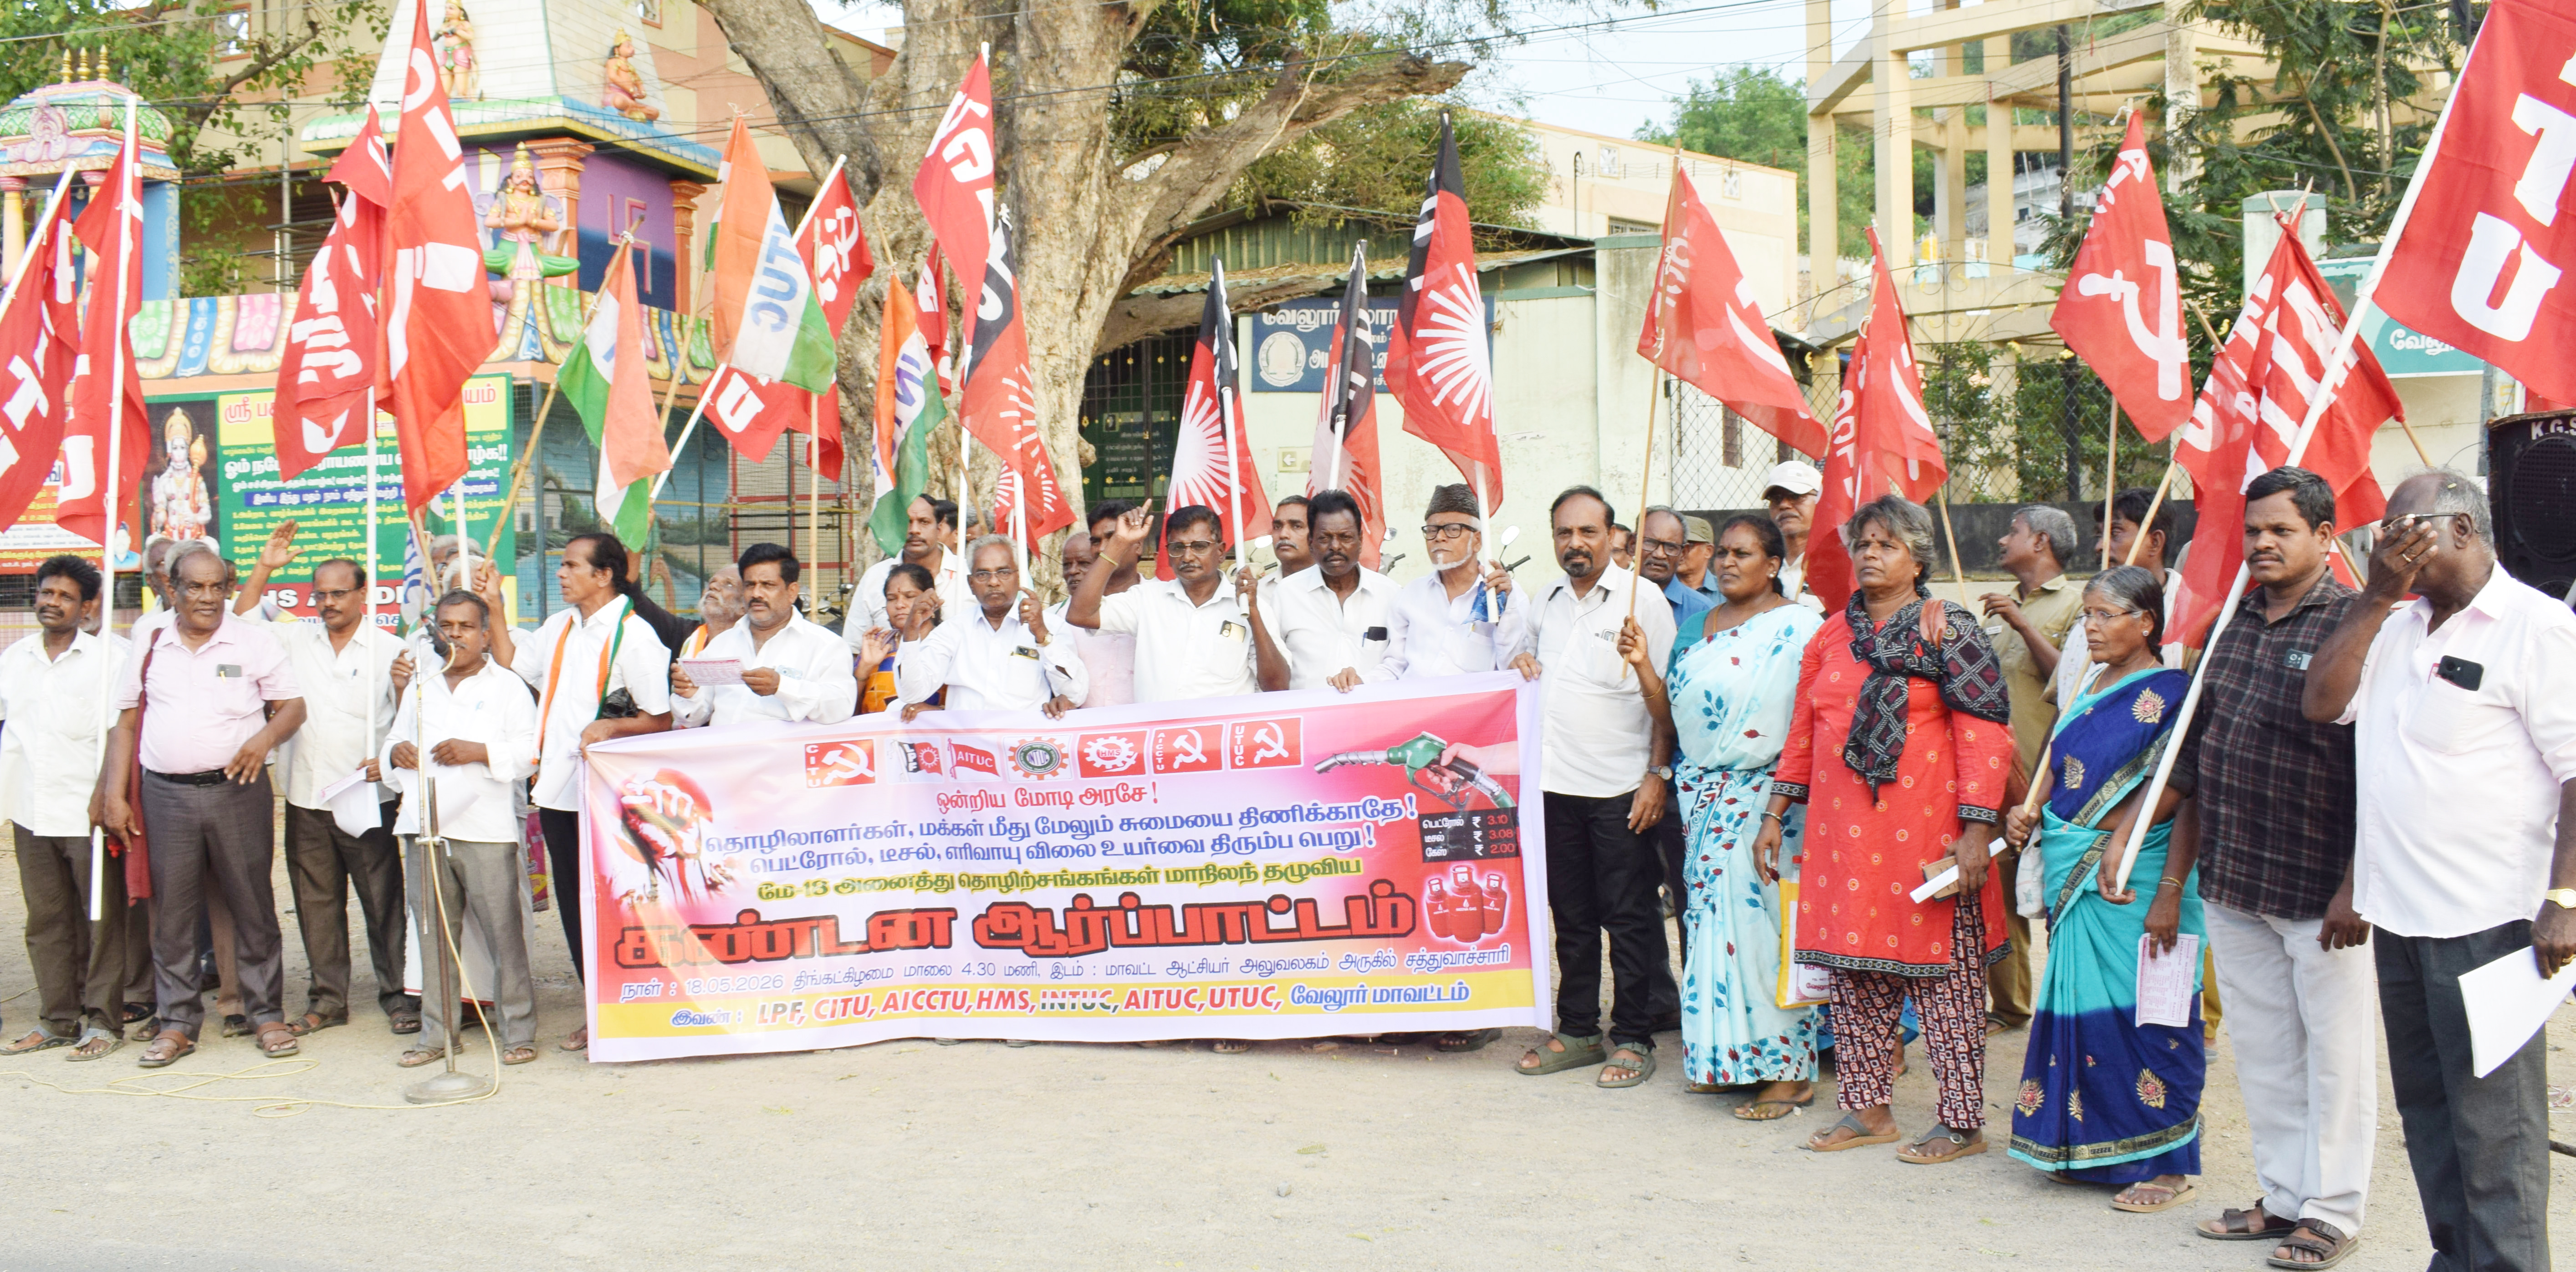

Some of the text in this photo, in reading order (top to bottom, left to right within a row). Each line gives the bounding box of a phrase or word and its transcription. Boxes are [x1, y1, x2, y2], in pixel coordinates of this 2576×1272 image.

[905, 743, 917, 773] LPF
[956, 751, 994, 768] AITUC
[1100, 748, 1122, 758] HMS
[1155, 732, 1165, 771] AICCTU
[1235, 725, 1245, 766] UTUC
[805, 745, 820, 787] CITU
[937, 790, 1006, 814] ஒன்றிய
[1015, 787, 1074, 809] மோடி
[705, 820, 914, 856] தொழிலாளர்கள்,
[920, 818, 984, 837] மக்கள்
[989, 816, 1030, 842] மீது
[1035, 814, 1113, 840] மேலும்
[1119, 812, 1233, 833] சுமையை
[1422, 816, 1464, 829] பெட்ரோல்
[1487, 814, 1508, 825] 3.10
[1424, 831, 1445, 843] டீசல்
[1488, 829, 1513, 839] 3.08
[751, 847, 874, 873] பெட்ரோல்,
[880, 843, 941, 863] டீசல்,
[946, 843, 1022, 864] எரிவாயு
[1026, 841, 1096, 858] விலை
[1102, 837, 1205, 856] உயர்வை
[1211, 831, 1293, 857] திரும்ப
[1425, 846, 1447, 857] கேஸ்
[1490, 843, 1515, 854] 2.00
[834, 872, 955, 895] அனைத்து
[958, 866, 1160, 894] தொழிற்சங்கங்கள்
[1165, 862, 1258, 888] மாநிலந்
[1264, 857, 1362, 885] தழுவிய
[615, 879, 1416, 969] கண்டன ஆர்ப்பாட்டம்
[620, 977, 661, 1002] நாள்
[686, 975, 784, 994] 18.05.2026
[792, 965, 894, 993] திங்கட்கிழமை
[904, 964, 952, 977] மாலை
[961, 962, 996, 977] 4.30
[1004, 963, 1041, 978] மணி,
[1050, 960, 1084, 980] இடம்
[1105, 963, 1156, 976] மாவட்ட
[1166, 956, 1229, 978] ஆட்சியர்
[1239, 950, 1329, 977] அலுவலகம்
[1338, 948, 1397, 972] அருகில்
[1404, 944, 1510, 973] சத்துவாச்சாரி
[813, 992, 875, 1019] CITU,
[1290, 982, 1369, 1011] வேலூர்
[1372, 981, 1470, 1003] மாவட்டம்
